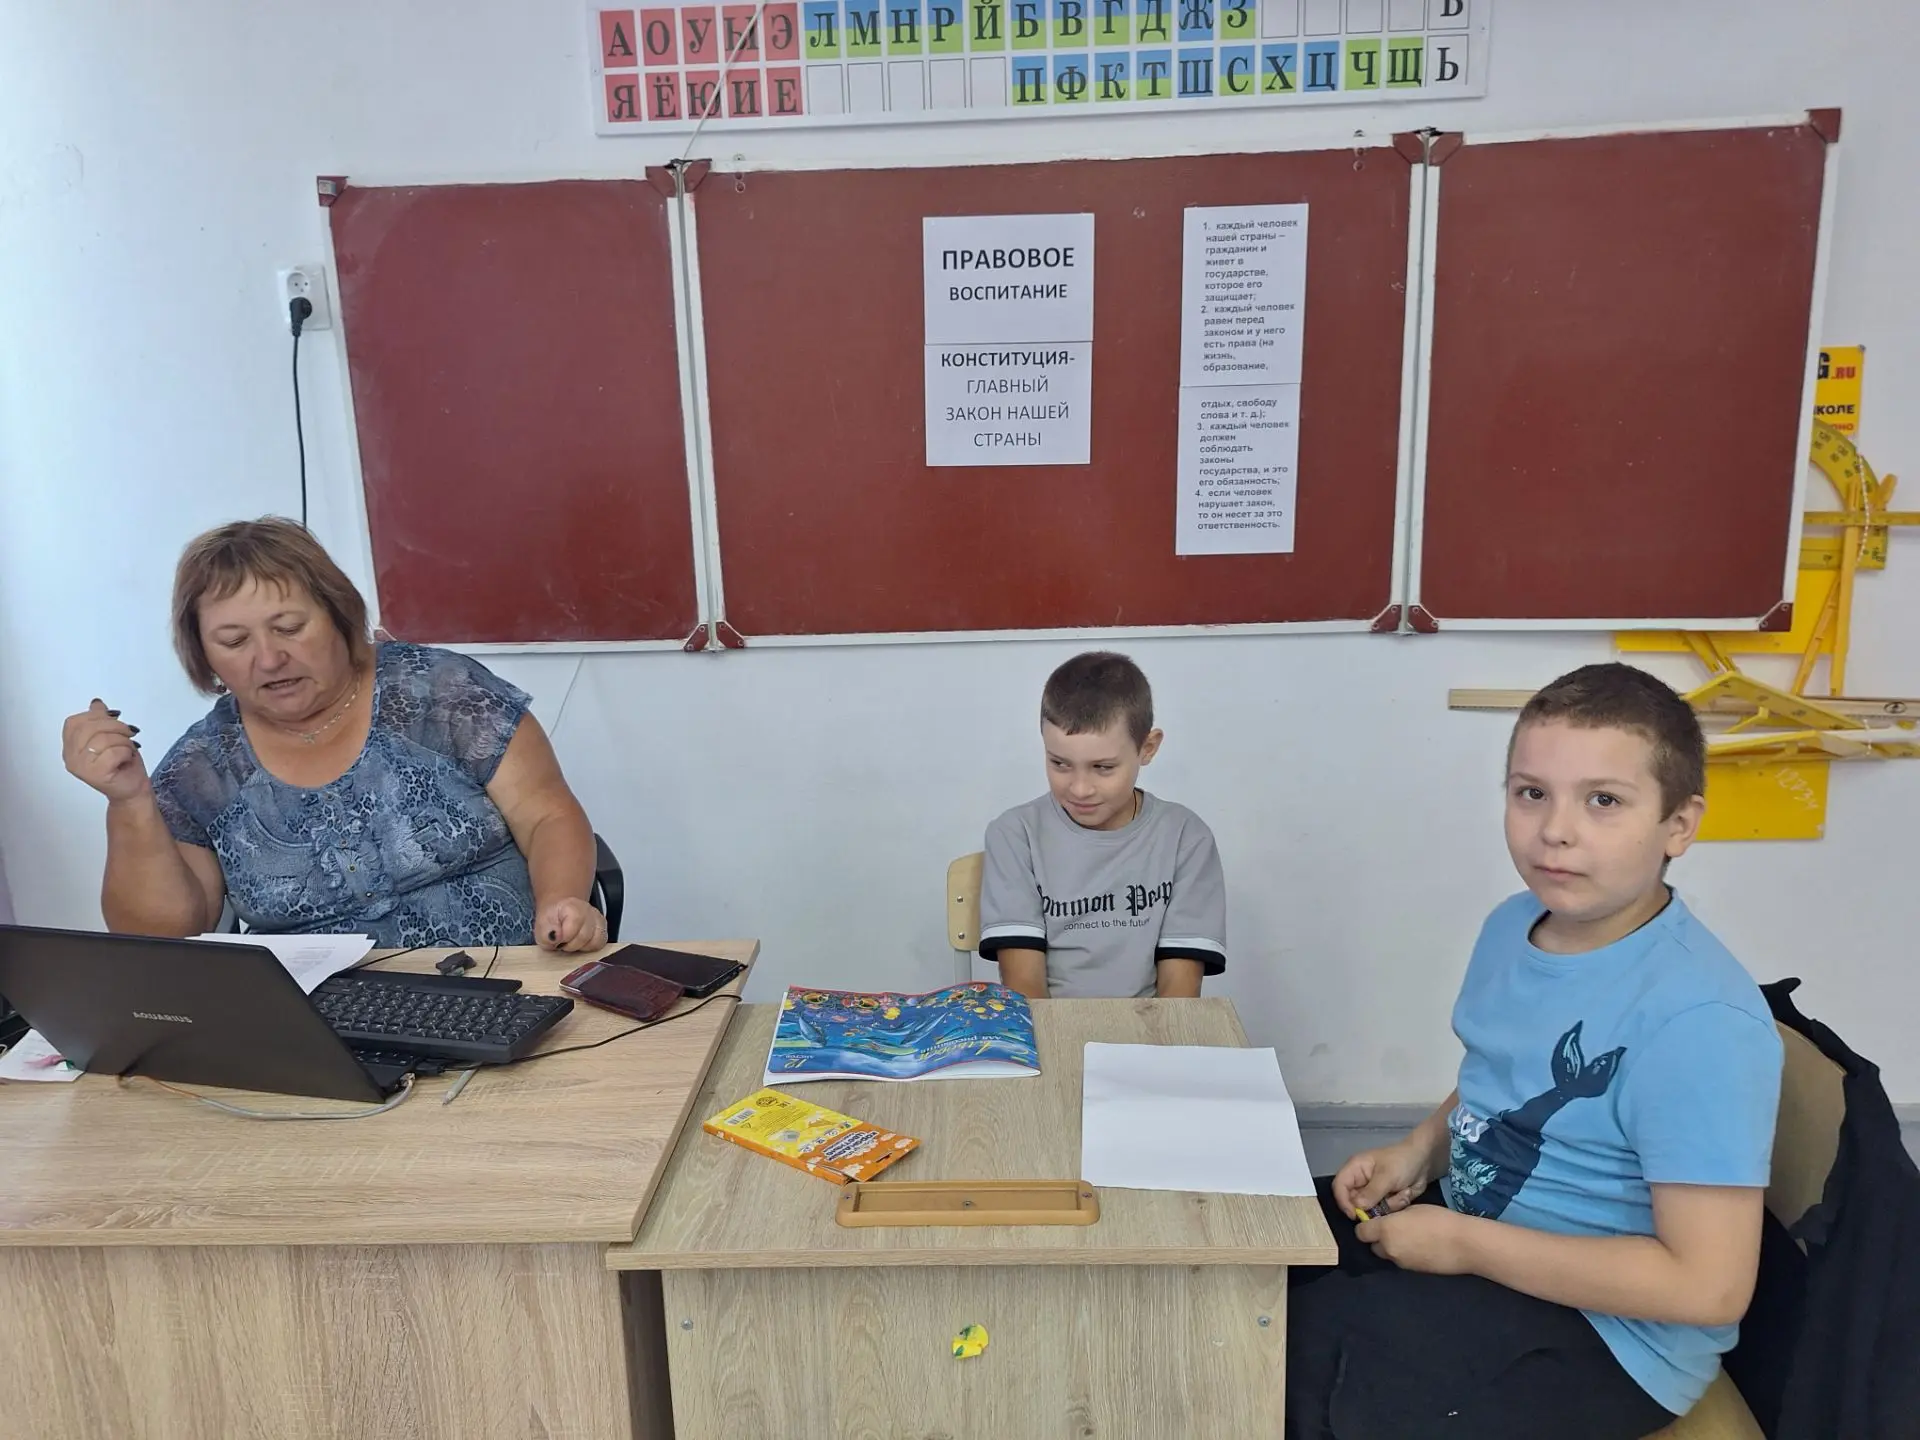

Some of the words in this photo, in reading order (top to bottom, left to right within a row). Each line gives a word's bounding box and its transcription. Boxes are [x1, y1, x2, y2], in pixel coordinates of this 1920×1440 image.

[607, 21, 634, 57] А
[646, 19, 671, 56] О
[687, 18, 712, 54] У
[770, 18, 793, 50] Э
[810, 12, 836, 48] Л
[851, 10, 881, 46] М
[892, 9, 920, 44] Н
[932, 7, 955, 42] Р
[973, 0, 1001, 40] Й
[1016, 3, 1040, 38] Б
[1058, 2, 1083, 36] В
[1101, 0, 1124, 34] Г
[1139, 0, 1167, 41] Д
[1178, 0, 1215, 30] Ж
[612, 84, 638, 120] Я
[652, 75, 676, 118] Ё
[731, 79, 759, 115] И
[775, 79, 797, 113] Е
[1016, 67, 1045, 103] П
[1055, 65, 1087, 100] Ф
[1099, 63, 1126, 99] К
[1142, 61, 1167, 97] Т
[1178, 58, 1214, 96] Ш
[1226, 55, 1249, 93] С
[1266, 54, 1294, 90] Х
[1307, 52, 1337, 91] Ц
[1350, 50, 1378, 86] Ч
[1386, 47, 1423, 86] Щ
[1203, 222, 1211, 230] 1.
[1215, 221, 1255, 231] каждый
[1257, 220, 1298, 229] человек
[1206, 233, 1237, 243] нашей
[1240, 233, 1277, 242] страны
[1205, 245, 1259, 256] гражданин
[942, 247, 1075, 270] ПРАВОВОЕ
[1205, 258, 1235, 266] живет
[1204, 282, 1244, 291] которое
[1246, 281, 1263, 289] его
[949, 284, 1068, 301] ВОСПИТАНИЕ
[1200, 305, 1209, 314] 2.
[1214, 305, 1252, 314] каждый
[1255, 303, 1295, 311] человек
[1204, 317, 1233, 327] равен
[1235, 315, 1265, 325] перед
[1204, 328, 1244, 337] законом
[1255, 328, 1261, 337] у
[1263, 327, 1286, 335] него
[1203, 341, 1225, 349] есть
[1227, 340, 1256, 350] права
[1259, 338, 1274, 347] (на
[941, 351, 1075, 368] КОНСТИТУЦИЯ-
[967, 375, 1049, 394] ГЛАВНЫЙ
[1200, 399, 1235, 409] отдых,
[1236, 398, 1277, 408] свободу
[945, 406, 1002, 421] ЗАКОН
[1007, 401, 1069, 420] НАШЕЙ
[1813, 404, 1855, 416] КОЛЕ
[1200, 412, 1229, 420] слова
[1197, 422, 1205, 431] 3.
[1209, 422, 1247, 431] каждый
[1250, 421, 1289, 429] человек
[973, 432, 1042, 447] СТРАНЫ
[1199, 434, 1236, 443] должен
[1199, 444, 1254, 454] соблюдать
[1200, 456, 1235, 465] законы
[1199, 479, 1215, 487] его
[1195, 489, 1203, 497] 4.
[1233, 488, 1273, 496] человек
[1198, 500, 1244, 510] нарушает
[1198, 511, 1208, 519] то
[1211, 511, 1223, 519] он
[1225, 510, 1252, 519] несет
[1254, 510, 1264, 518] за
[1266, 509, 1283, 518] это
[1063, 920, 1099, 931] connect
[1101, 919, 1111, 928] to
[1112, 919, 1127, 928] the
[133, 1011, 192, 1023] AQUARIUS
